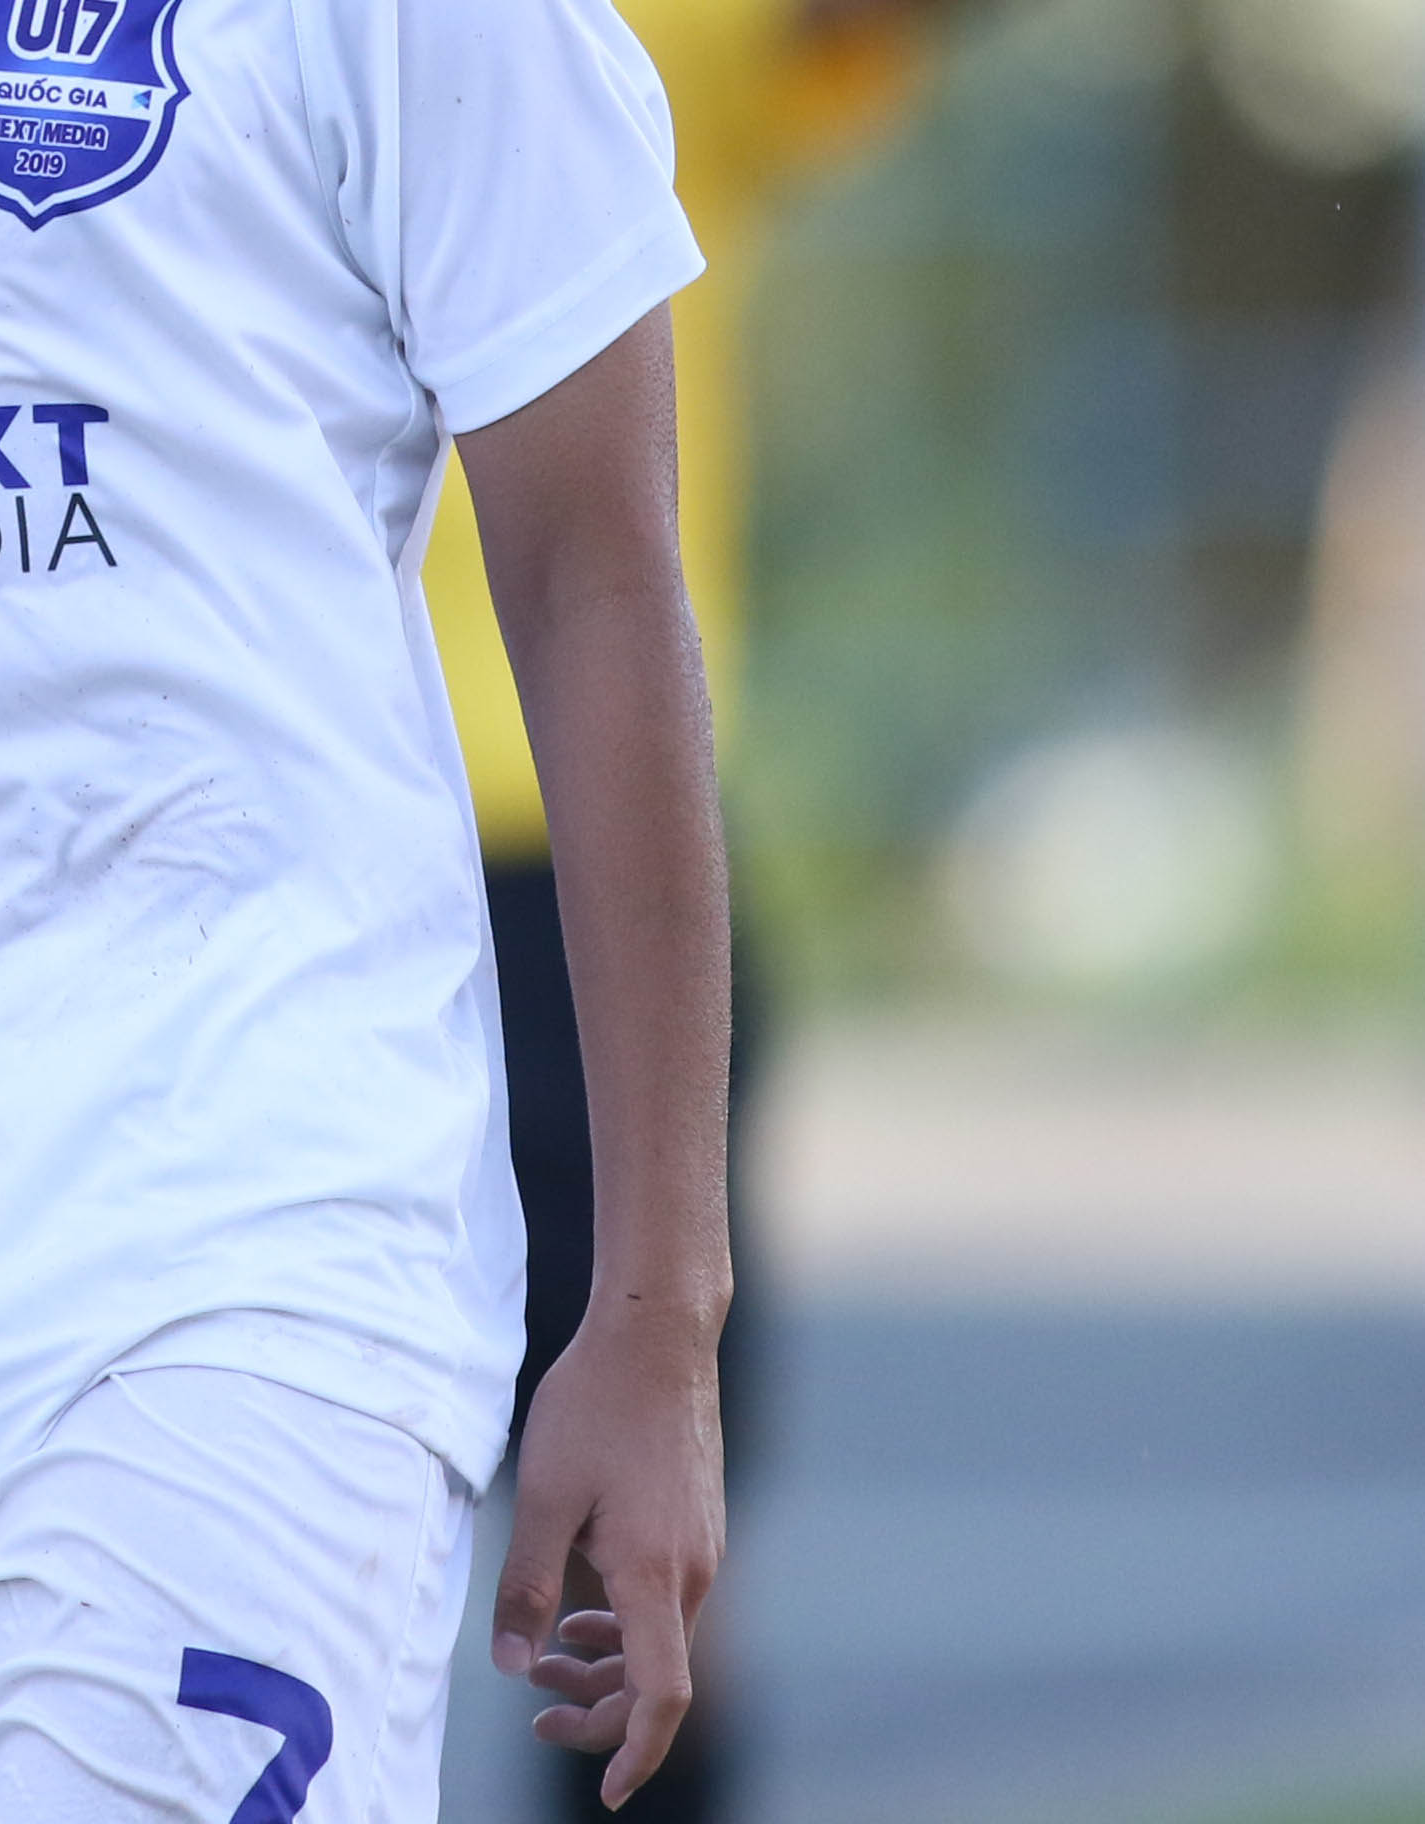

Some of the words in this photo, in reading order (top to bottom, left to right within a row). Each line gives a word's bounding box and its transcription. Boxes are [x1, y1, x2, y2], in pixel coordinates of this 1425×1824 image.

[68, 87, 108, 109] GIA
[42, 121, 107, 149] MEDIA
[15, 150, 64, 176] 2019
[176, 1646, 334, 1824] 7
